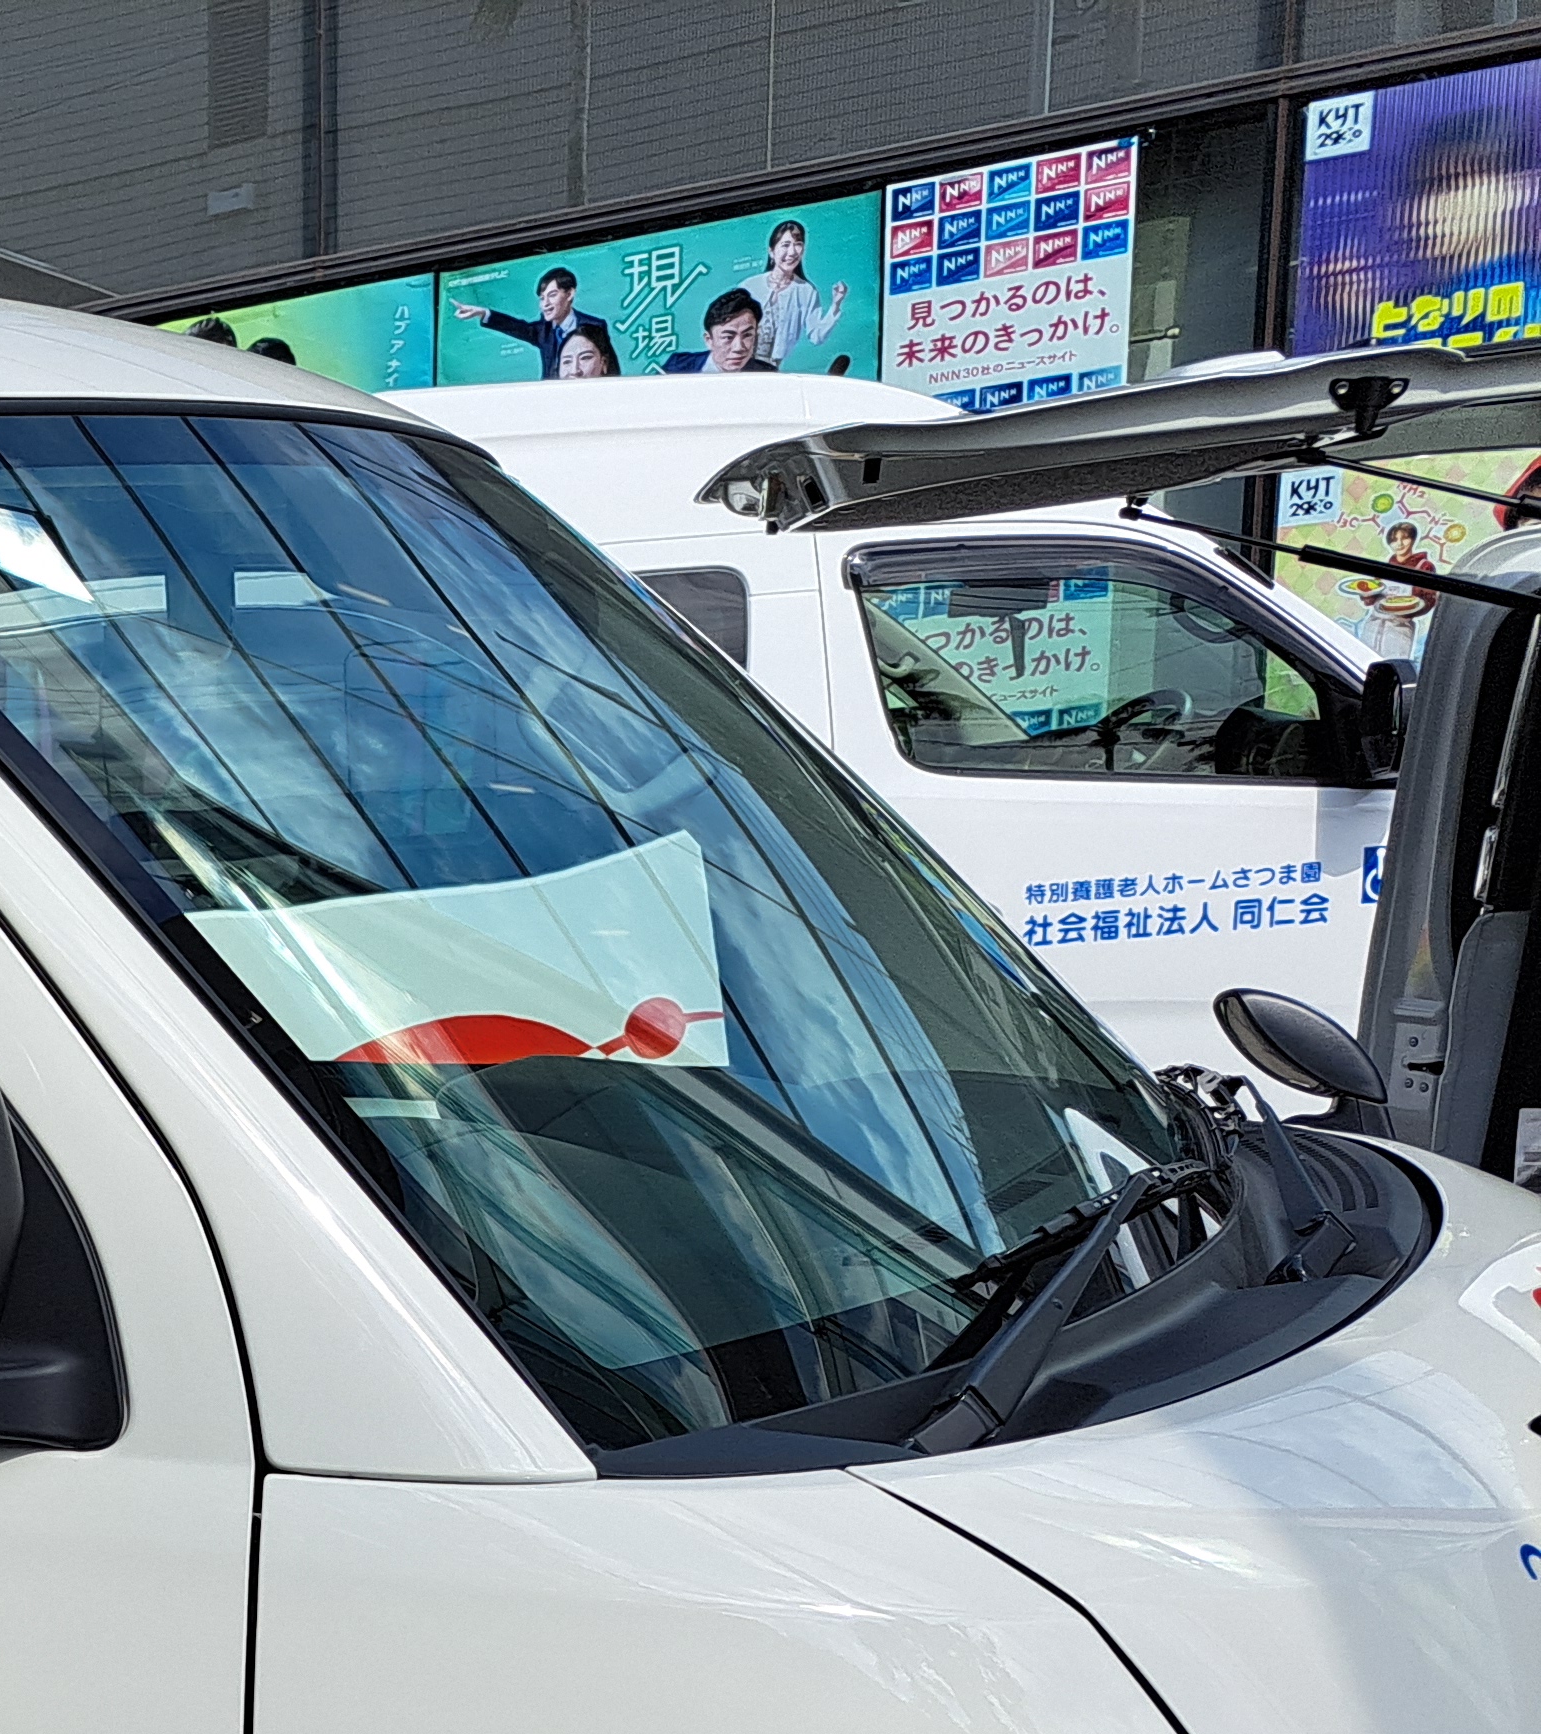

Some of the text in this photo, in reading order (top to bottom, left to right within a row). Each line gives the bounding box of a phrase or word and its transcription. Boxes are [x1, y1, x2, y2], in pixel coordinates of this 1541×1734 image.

[898, 149, 1125, 213] NNN NNN NNN NNN NNN
[897, 187, 1124, 249] NNN NNN NNN NNN NNN
[896, 226, 1122, 285] NNN NNN NNN NNN NNN
[906, 272, 1108, 331] 見つかるのは、
[1372, 281, 1525, 339] となりの
[895, 307, 1121, 368] 未来のきっかけ。
[928, 350, 1077, 385] NNN30社のニュースサイト
[1034, 380, 1066, 400] NNN
[919, 612, 1088, 653] つかるのは、
[1024, 861, 1322, 905] 特別養護老人ホームさつま園
[1023, 893, 1330, 946] 社会福祉法人 同仁会
